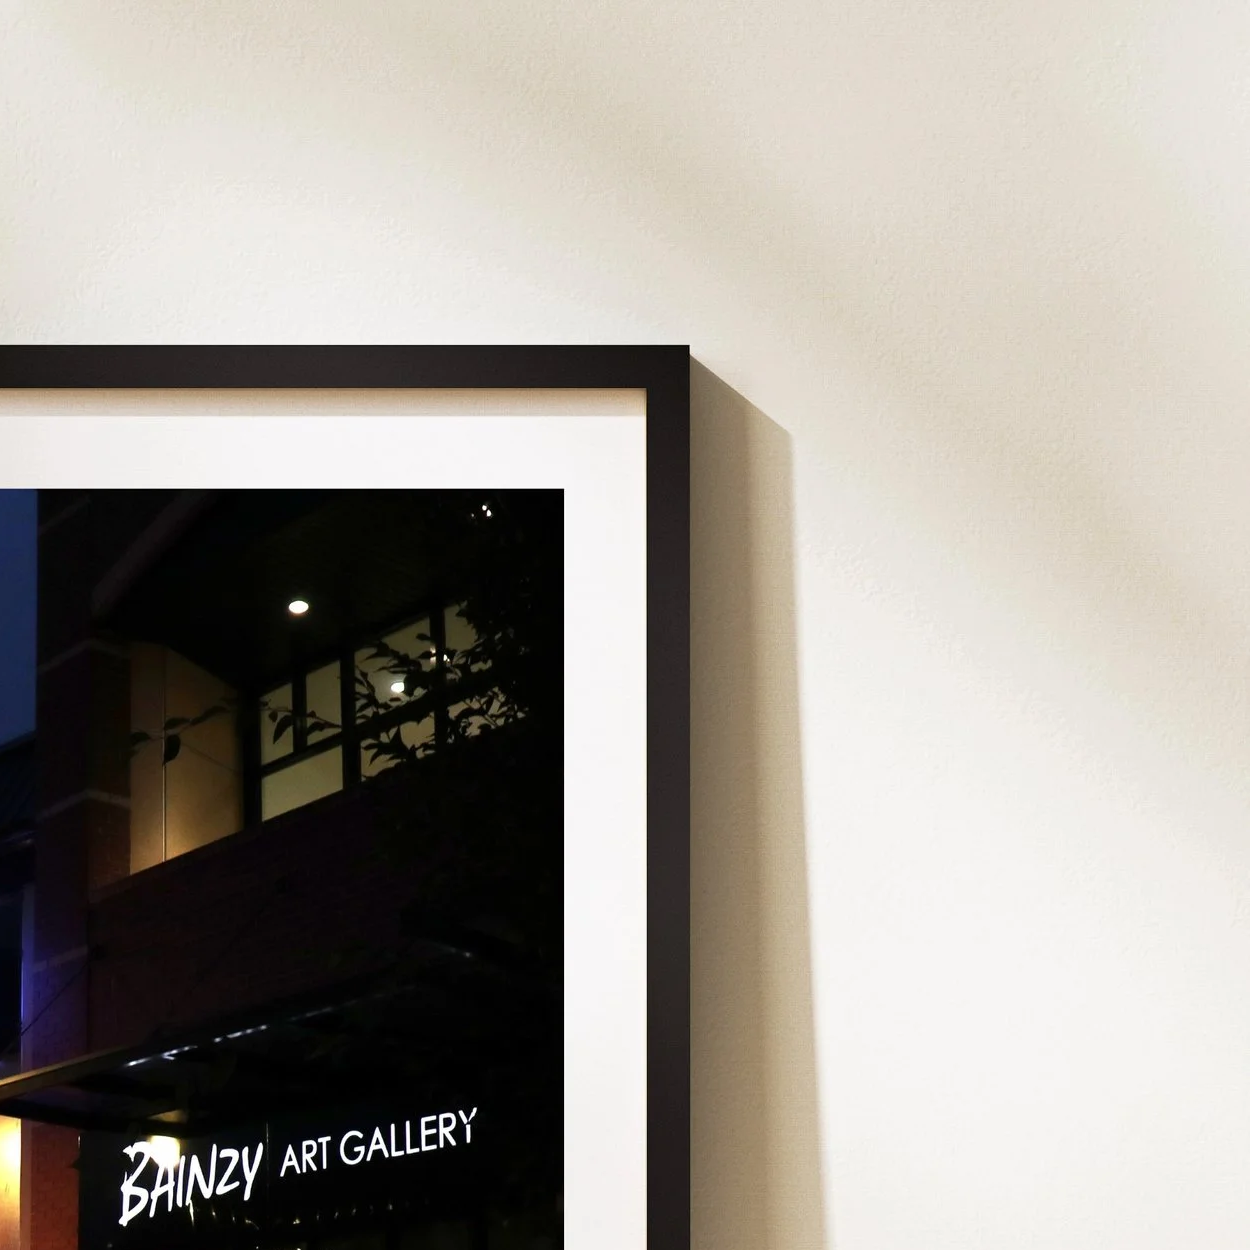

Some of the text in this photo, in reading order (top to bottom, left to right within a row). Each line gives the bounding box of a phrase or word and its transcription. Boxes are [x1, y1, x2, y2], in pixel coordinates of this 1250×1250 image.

[118, 1107, 477, 1227] BAINZY ART GALLERY
